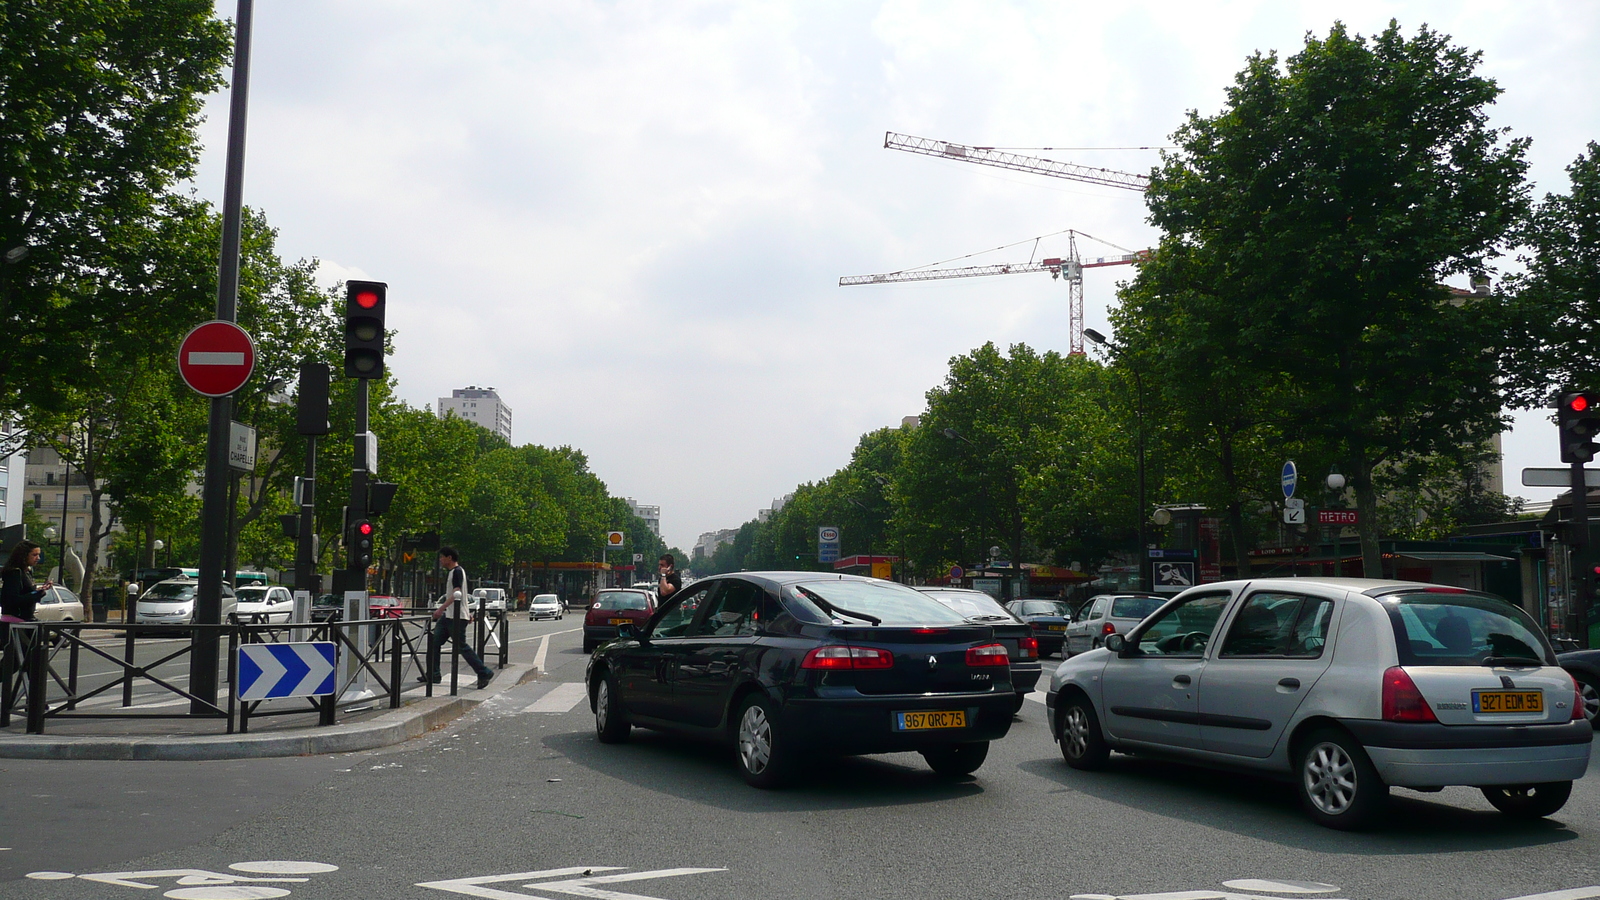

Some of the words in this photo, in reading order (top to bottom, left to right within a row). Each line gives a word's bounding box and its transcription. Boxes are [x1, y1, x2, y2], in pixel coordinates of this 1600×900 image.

[230, 450, 253, 465] CHAPELLE
[1320, 512, 1356, 522] METRO
[1481, 694, 1501, 710] 927
[1505, 694, 1524, 710] EDM
[1526, 694, 1539, 709] 95
[905, 713, 926, 728] 967
[927, 713, 948, 727] QRC
[949, 712, 962, 726] 75
